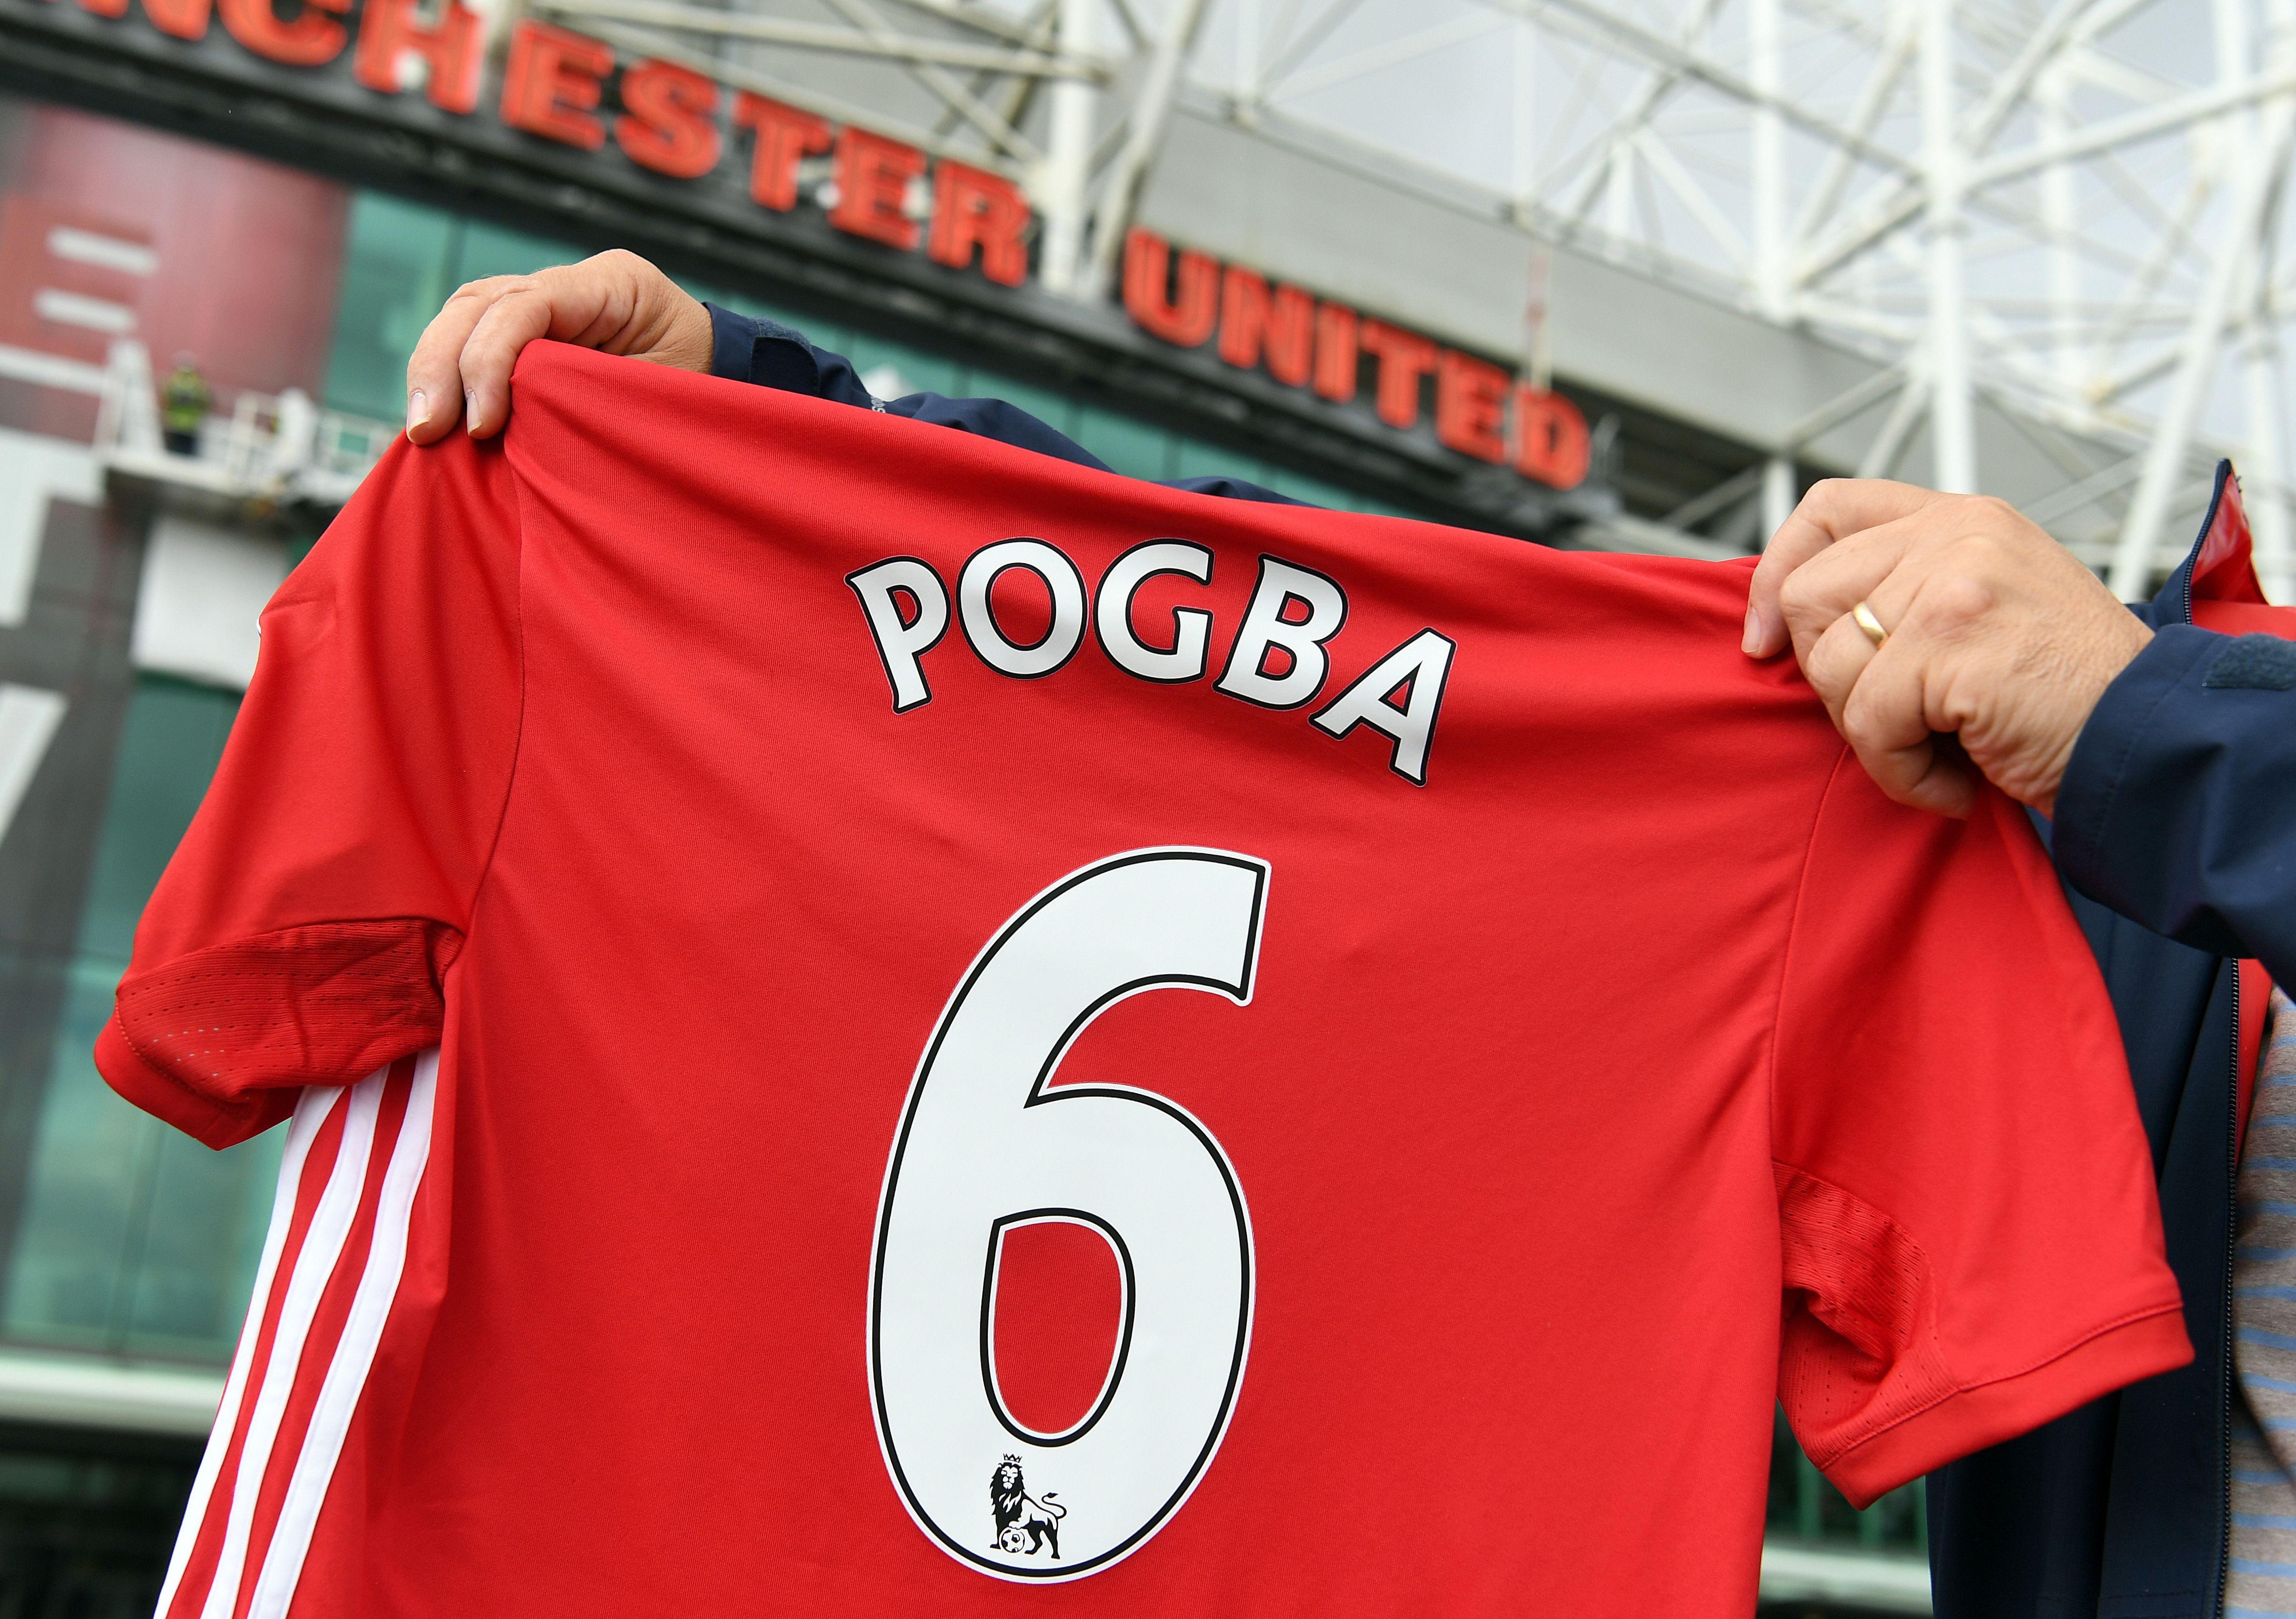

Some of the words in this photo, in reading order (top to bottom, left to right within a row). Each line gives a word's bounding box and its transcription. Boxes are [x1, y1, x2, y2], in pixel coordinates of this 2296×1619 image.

[1122, 228, 1591, 490] UNITED
[845, 537, 1457, 787] POGBA
[866, 845, 1272, 1584] 6
